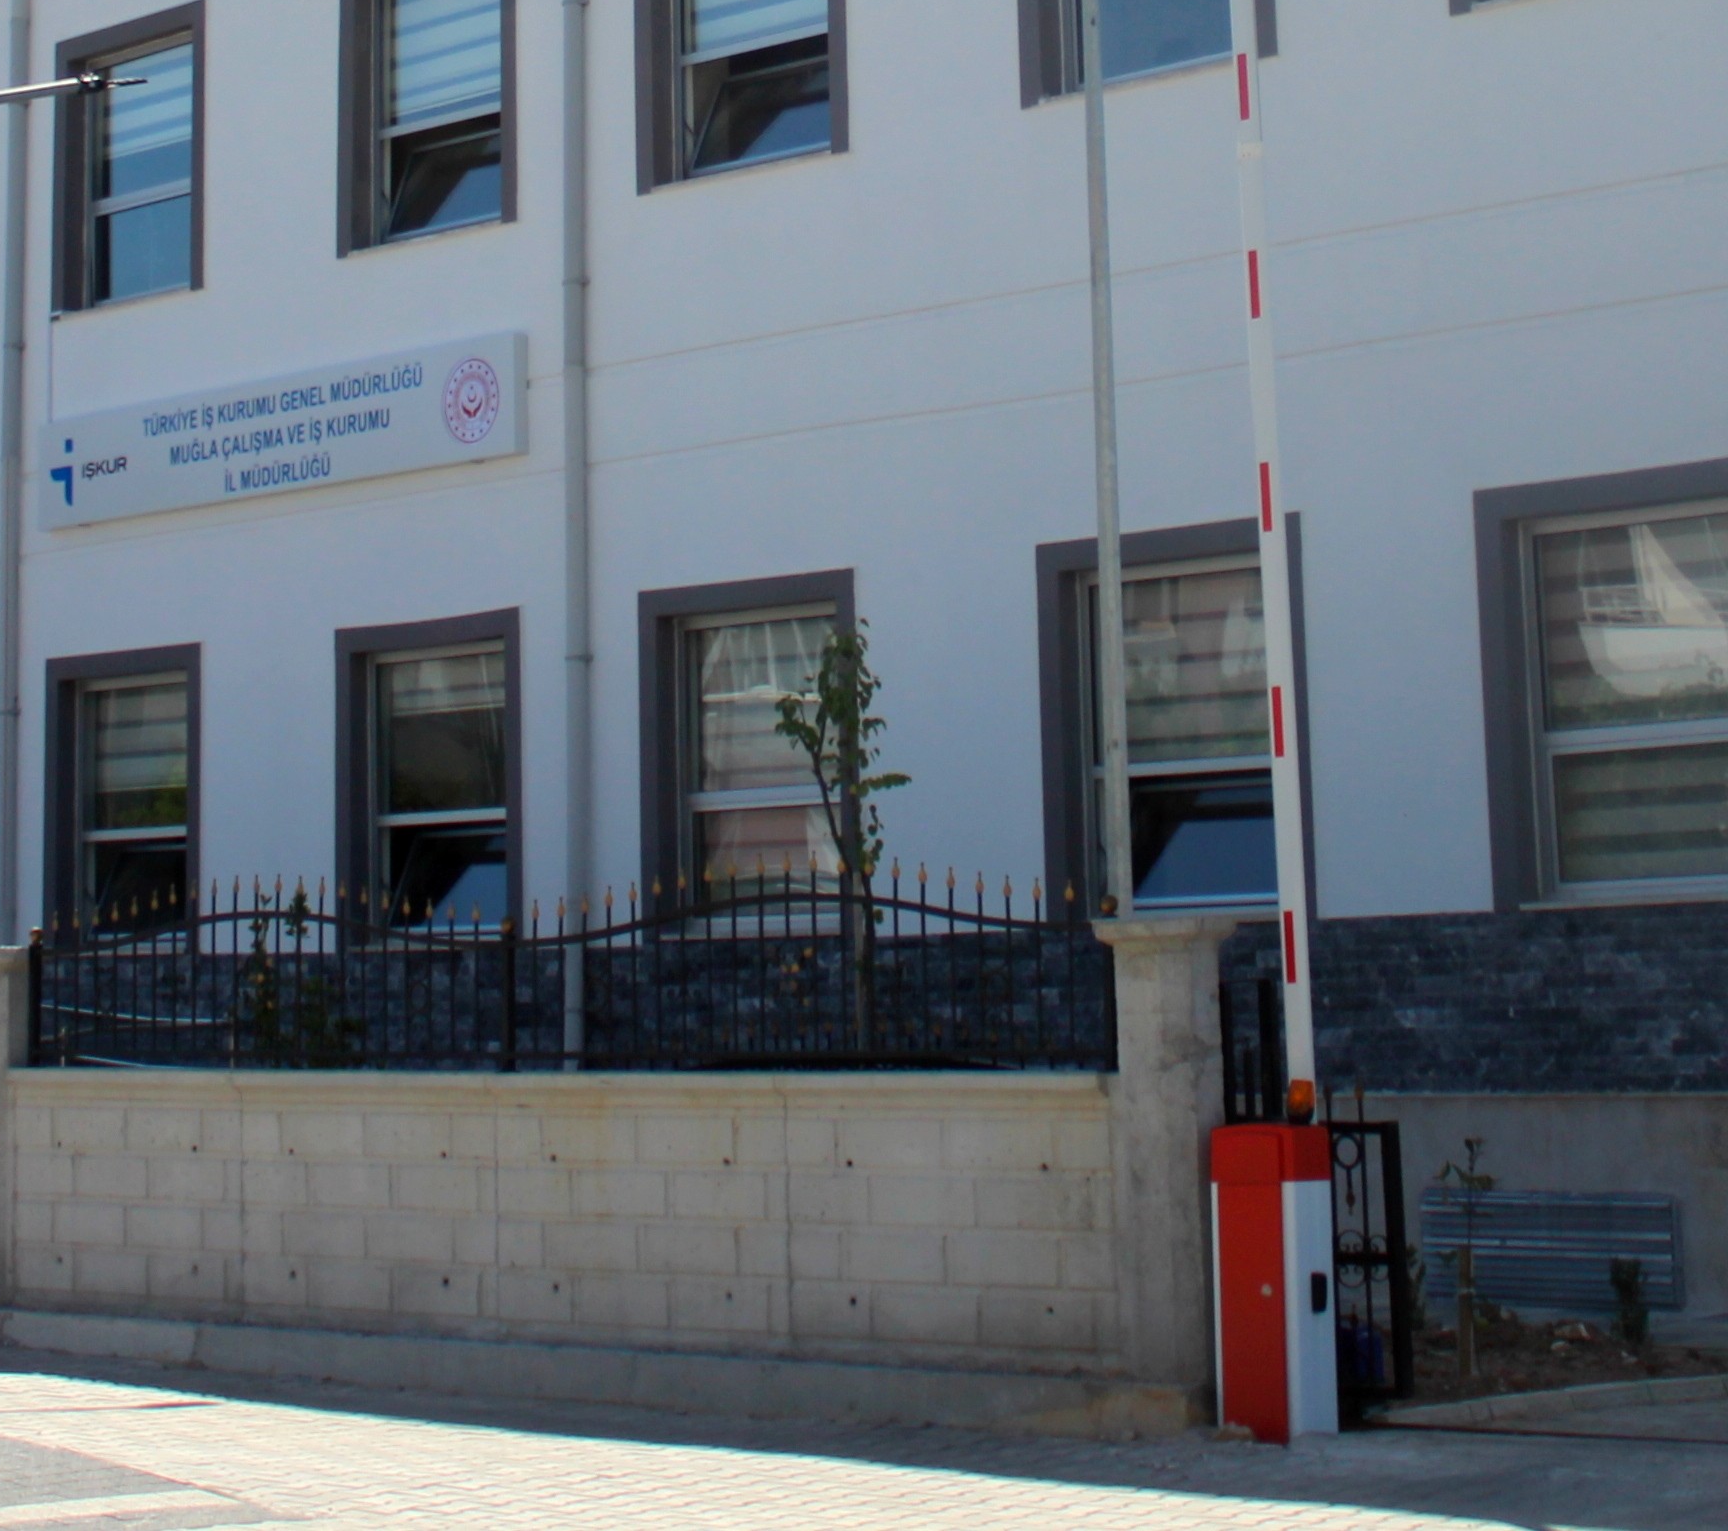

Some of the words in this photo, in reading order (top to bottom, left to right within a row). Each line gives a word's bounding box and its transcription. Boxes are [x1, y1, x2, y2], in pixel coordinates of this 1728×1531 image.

[143, 408, 198, 437] TÜRKİYE
[202, 402, 214, 430] İŞ
[218, 394, 276, 423] KURUMU
[280, 386, 326, 412] GENEL
[330, 362, 423, 402] MÜDÜRLÜĞÜ
[170, 438, 219, 466] MUĞLA
[222, 428, 284, 461] ÇALIŞMA
[287, 423, 305, 445] VE
[309, 417, 322, 445] İŞ
[327, 408, 390, 438] KURUMU
[225, 468, 237, 493] İL
[239, 452, 331, 490] MÜDÜRLÜĞÜ
